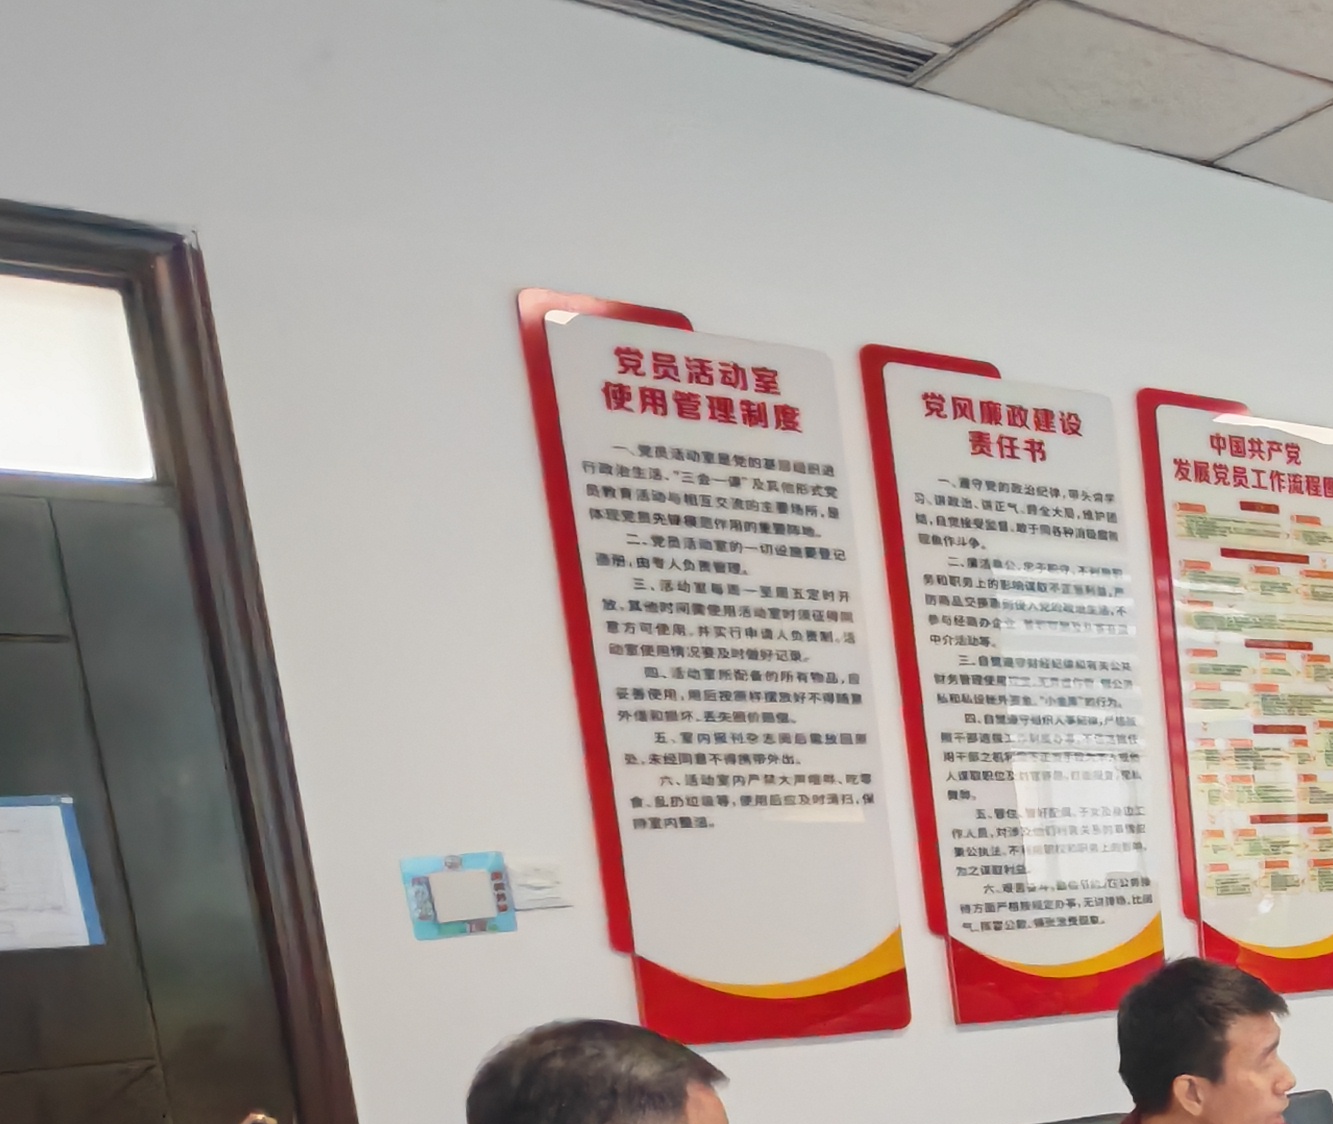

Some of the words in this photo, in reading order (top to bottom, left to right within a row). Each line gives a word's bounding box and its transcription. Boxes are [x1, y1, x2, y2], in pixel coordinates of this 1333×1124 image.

[613, 345, 781, 396] 党员活动室
[601, 381, 804, 434] 使用管理制度
[921, 391, 1084, 437] 党风廉政建设
[968, 431, 1048, 463] 责任书
[1209, 433, 1302, 466] 中国共产党
